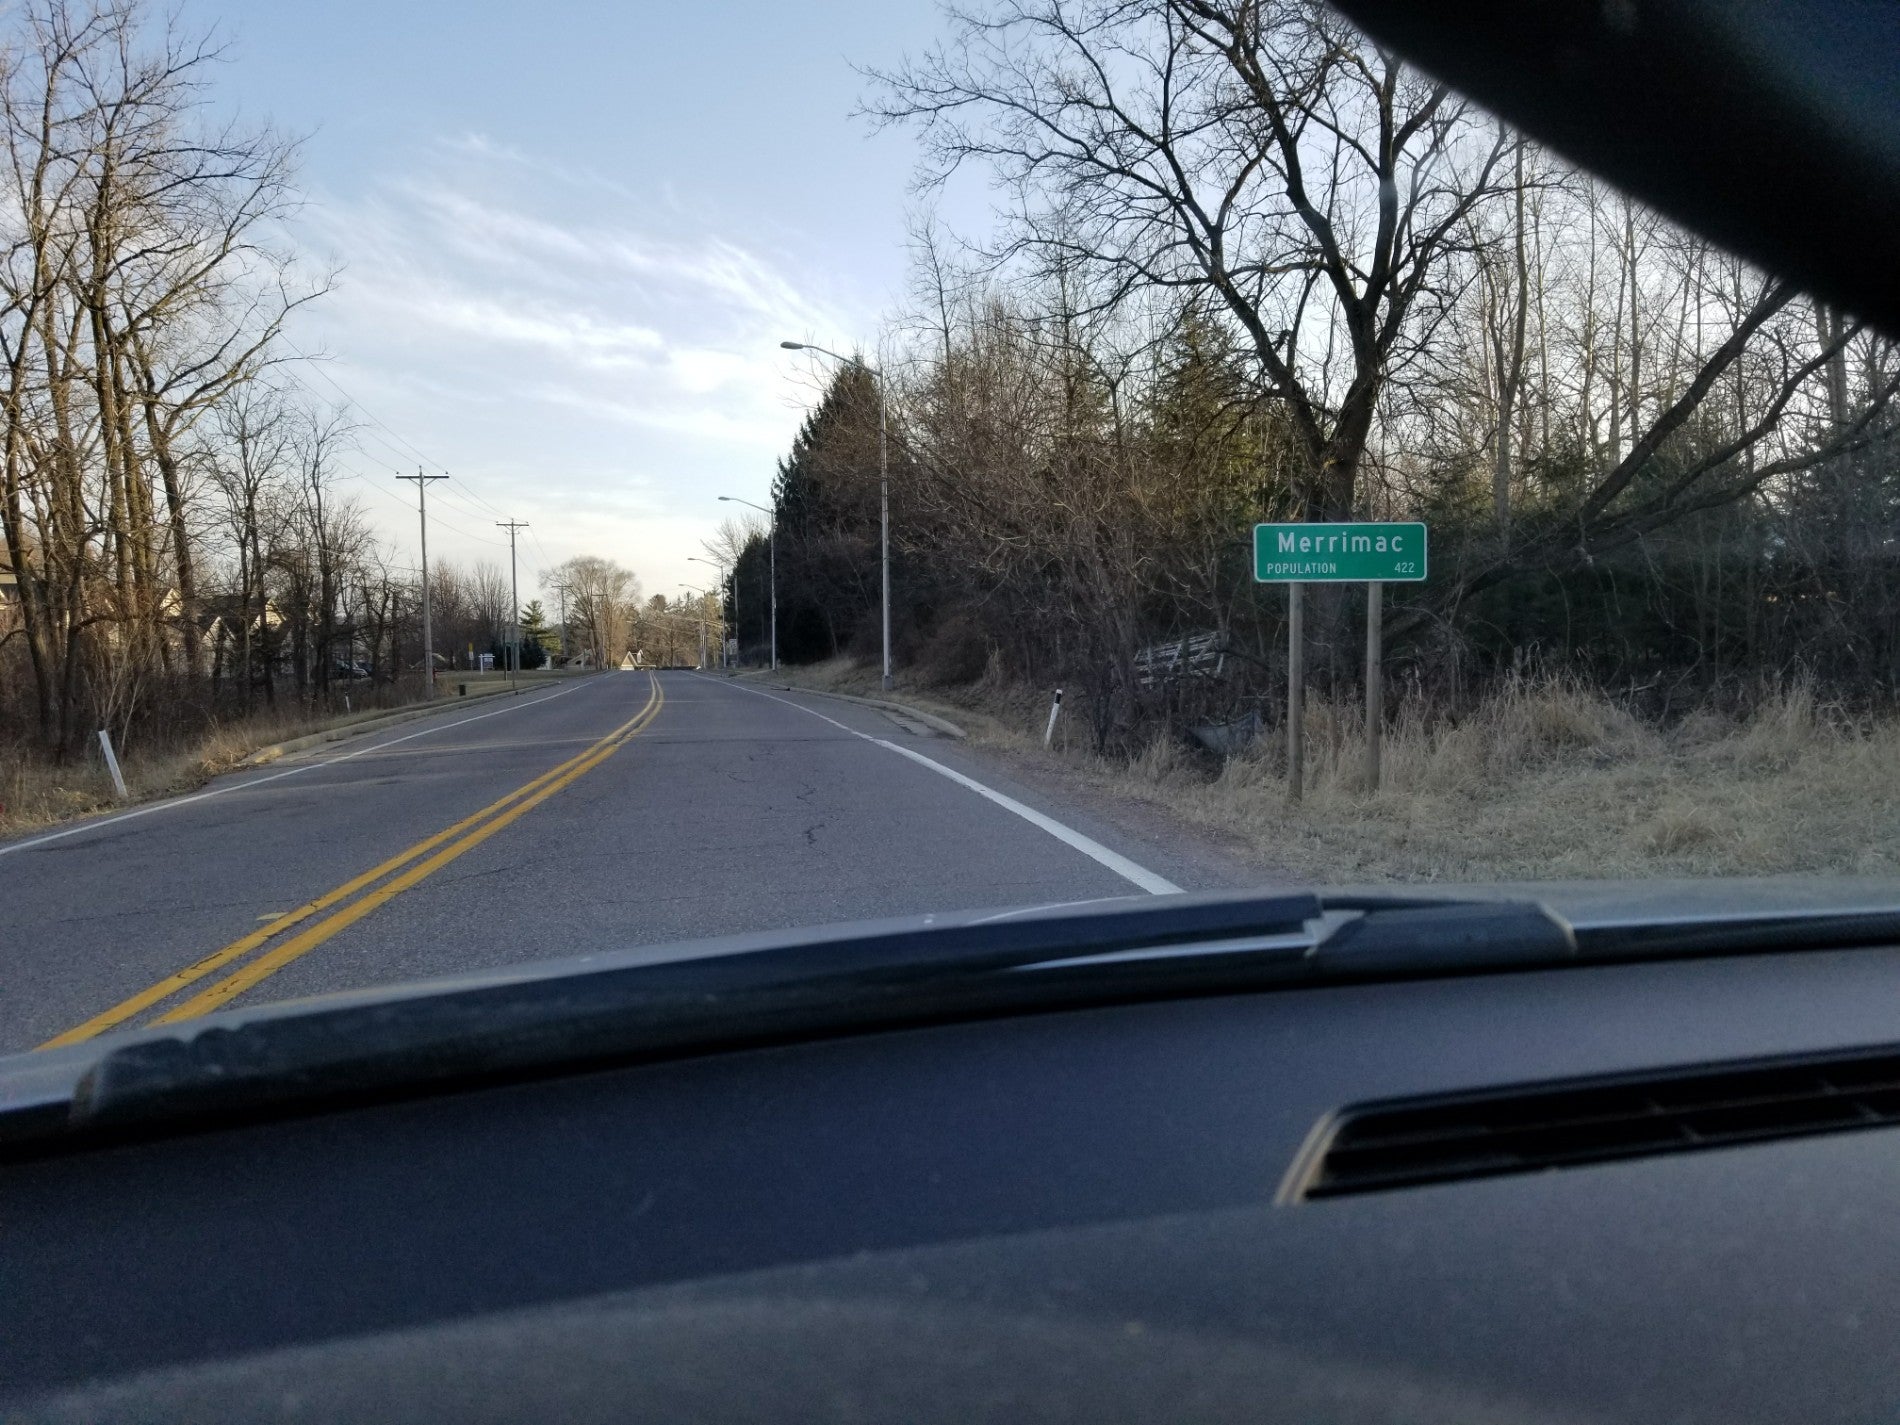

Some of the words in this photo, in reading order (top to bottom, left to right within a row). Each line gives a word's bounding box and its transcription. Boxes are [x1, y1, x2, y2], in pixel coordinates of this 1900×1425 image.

[1278, 531, 1404, 553] Merrimac
[1267, 562, 1336, 574] POPULATION
[1394, 562, 1415, 573] 422
